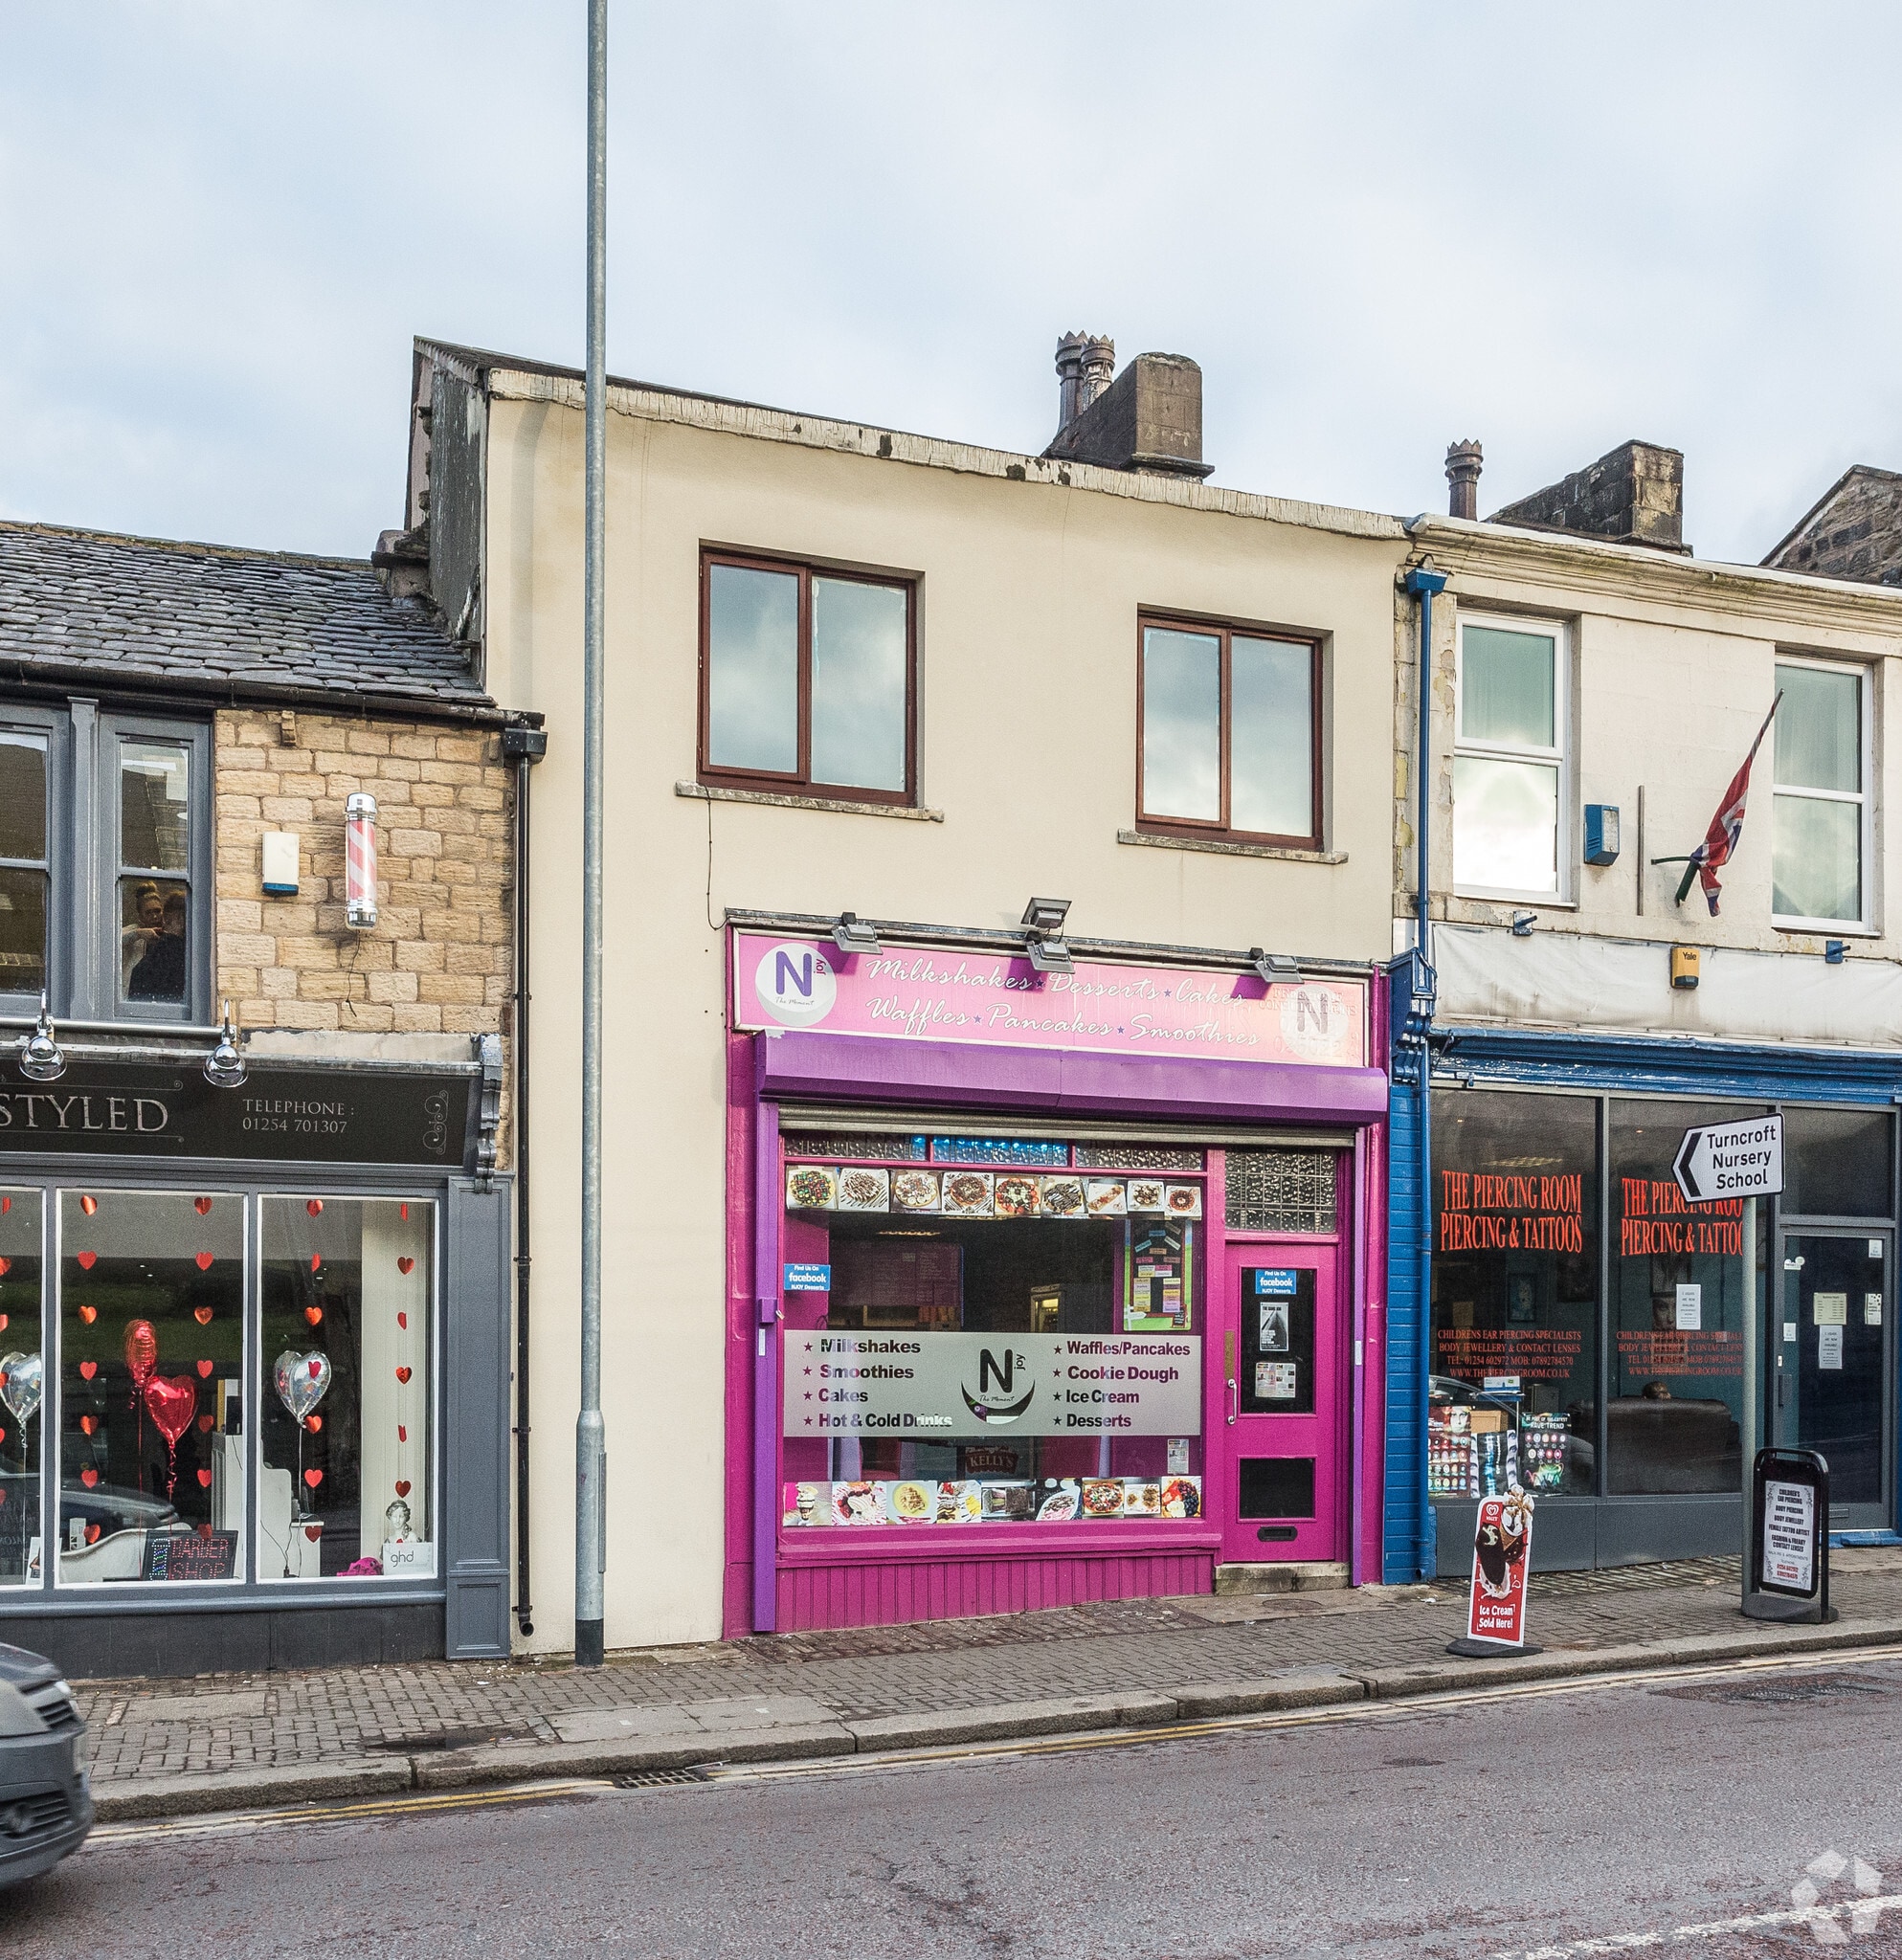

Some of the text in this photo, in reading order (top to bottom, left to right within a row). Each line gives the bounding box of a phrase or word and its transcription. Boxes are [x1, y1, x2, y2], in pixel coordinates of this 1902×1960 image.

[1683, 951, 1696, 961] Yale
[865, 957, 1247, 1007] Milkshakes Desserts Cakes
[865, 995, 1261, 1045] Waffles Pancakes Smoothies
[242, 1117, 347, 1133] 01254 701307
[1707, 1125, 1776, 1148] Turncroft
[1713, 1150, 1772, 1169] Nursery
[1716, 1169, 1768, 1190] School
[1443, 1170, 1581, 1214] THE PIERCING ROOM
[1622, 1177, 1648, 1216] THE
[1441, 1212, 1582, 1254] PIERCING & TATTOOS
[1622, 1218, 1683, 1256] PIERCING
[1685, 1222, 1695, 1254] &
[789, 1272, 826, 1282] facebook
[1260, 1277, 1292, 1286] facebook
[1438, 1329, 1581, 1340] CHILDRENS EAR PIERCING SPECIALISTS
[820, 1338, 921, 1353] Milkshakes
[1067, 1341, 1191, 1355] Waffles/Pancakes
[1439, 1343, 1580, 1353] BODY JEWELLERY & CONTACT LENSES
[819, 1364, 914, 1378] Smoothies
[1067, 1366, 1178, 1383] Cookie Dough
[818, 1388, 869, 1402] Cakes
[1066, 1390, 1139, 1403] Ice Cream
[818, 1414, 953, 1427] Hot & Cold Drinks
[1066, 1414, 1131, 1427] Desserts
[172, 1538, 229, 1558] BARBER
[391, 1549, 414, 1567] ghd
[172, 1562, 225, 1580] SHOP
[1479, 1605, 1513, 1615] Ice Cream
[1479, 1617, 1513, 1629] Sold Here!
